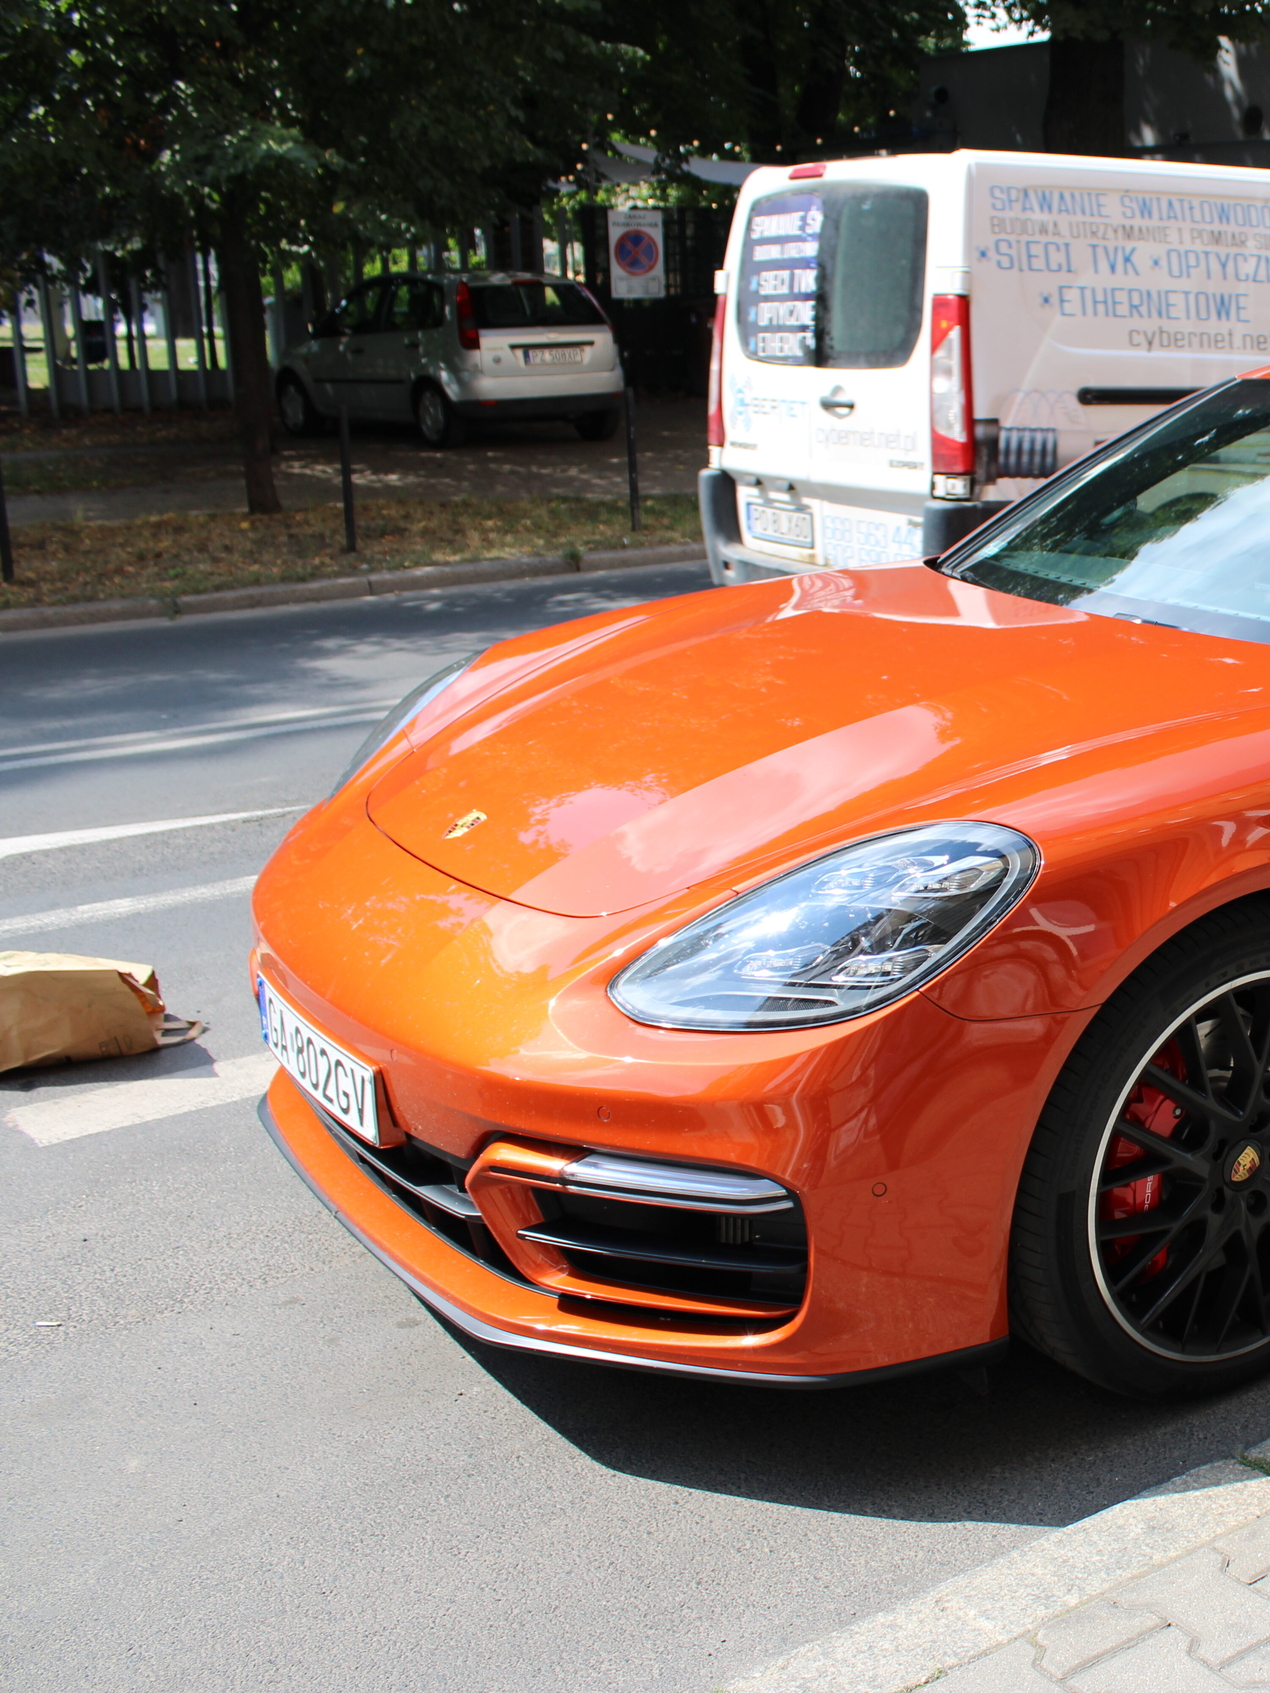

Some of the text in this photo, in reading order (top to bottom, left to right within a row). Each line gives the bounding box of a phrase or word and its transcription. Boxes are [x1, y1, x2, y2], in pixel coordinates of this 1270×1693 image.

[989, 184, 1112, 218] SPAWANIE
[1068, 220, 1174, 244] UTRZYMANIE
[1177, 226, 1185, 245] I
[1190, 227, 1249, 249] POMIAR
[994, 237, 1075, 274] SIECI
[1086, 243, 1141, 276] TVK
[1057, 284, 1252, 323] ETHERNETOWE
[855, 519, 889, 549] 563
[268, 996, 366, 1128] GA 802GV
